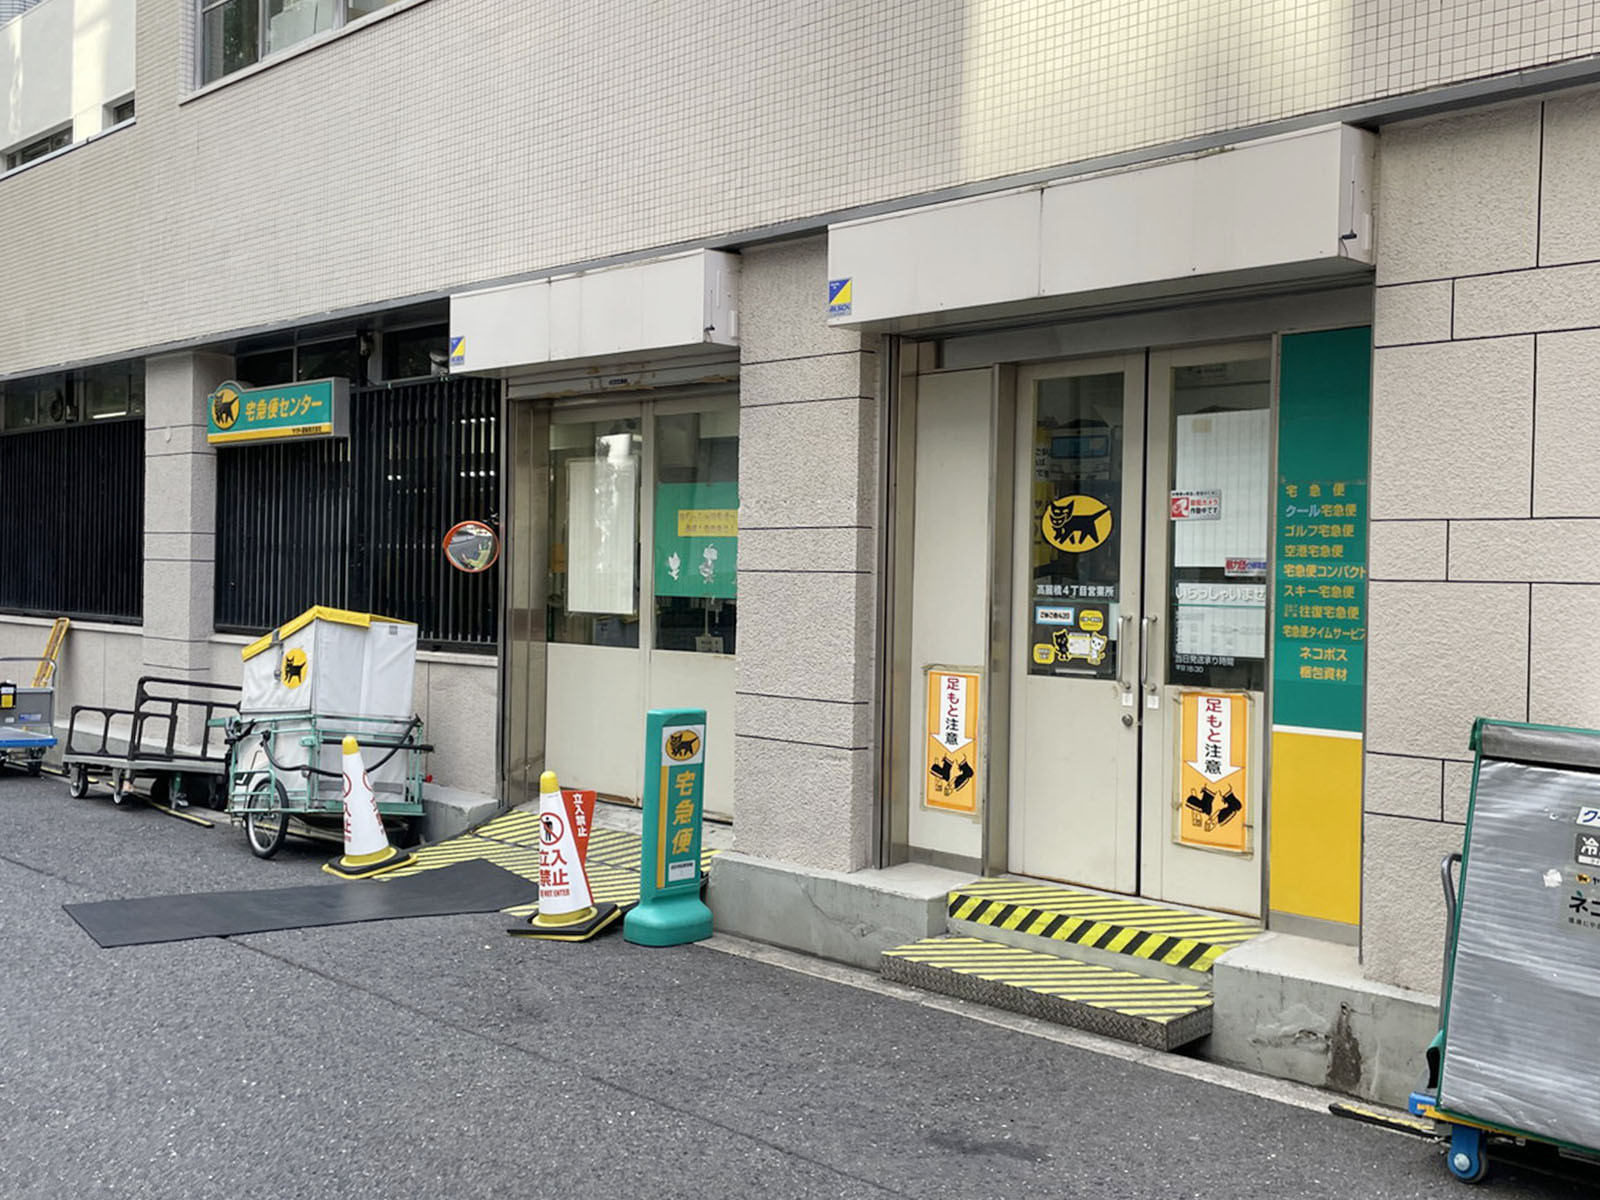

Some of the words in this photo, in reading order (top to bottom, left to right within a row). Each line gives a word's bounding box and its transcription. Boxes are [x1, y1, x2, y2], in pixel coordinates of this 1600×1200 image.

[245, 394, 323, 422] 宅急便センター
[1285, 482, 1345, 498] 宅急便
[1285, 504, 1357, 517] クール宅急便
[1284, 523, 1354, 537] ゴルフ宅急便
[1284, 544, 1344, 558] 空港宅急便
[1283, 564, 1367, 579] 宅急便コンパクト
[1284, 585, 1355, 599] スキー宅急便
[1300, 605, 1359, 619] 往復宅急便
[1299, 646, 1348, 661] ネコポス
[945, 677, 960, 746] 足もと注意
[1204, 698, 1222, 775] 足もと注意
[572, 793, 588, 837] 立入禁止
[672, 770, 696, 855] 宅急便
[540, 849, 568, 866] 立入
[540, 868, 570, 887] 禁止
